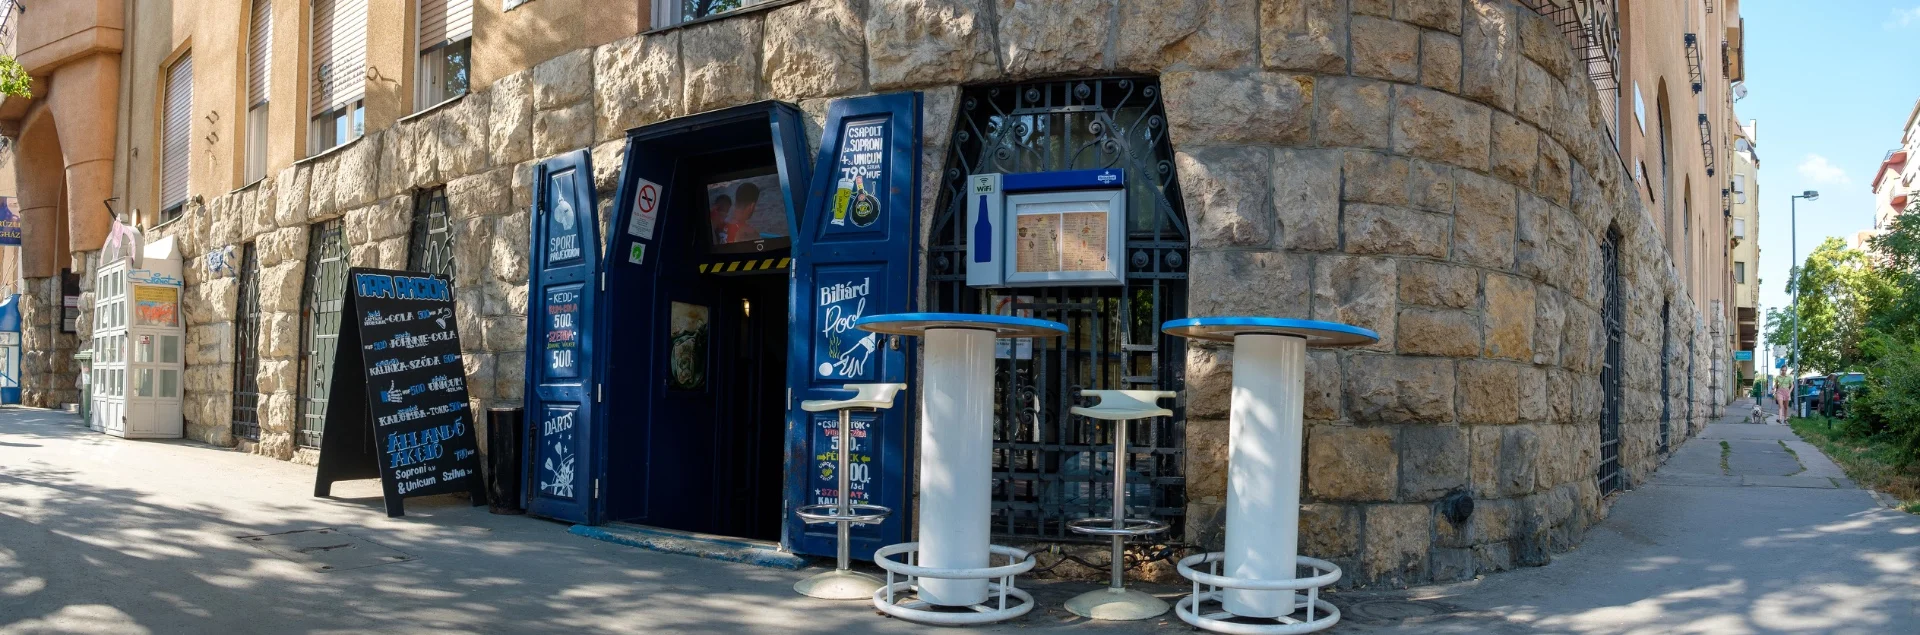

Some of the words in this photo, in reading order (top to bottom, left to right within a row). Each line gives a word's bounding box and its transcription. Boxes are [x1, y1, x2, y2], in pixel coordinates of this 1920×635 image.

[848, 126, 882, 138] CSAPOLT
[850, 137, 882, 152] SOPRONI
[853, 151, 882, 166] UNICUM
[866, 171, 882, 179] HUF
[550, 233, 577, 252] SPORT
[356, 273, 395, 299] NAPI
[394, 274, 451, 302] AKCIÓK
[820, 277, 870, 306] Biliárd
[553, 292, 573, 303] KEDD
[548, 329, 574, 342] SZERDA
[373, 340, 388, 350] 500
[443, 353, 456, 364] 500
[410, 383, 426, 396] 500
[449, 401, 462, 412] 500
[544, 411, 573, 436] DARTS
[387, 416, 465, 454] ÁLLANDÓ
[390, 441, 444, 469] AKCIÓ
[395, 463, 427, 480] Soproni
[442, 468, 466, 481] Szilva
[397, 482, 406, 494] &
[405, 476, 437, 492] Unicum
[821, 487, 863, 499] SZOAT
